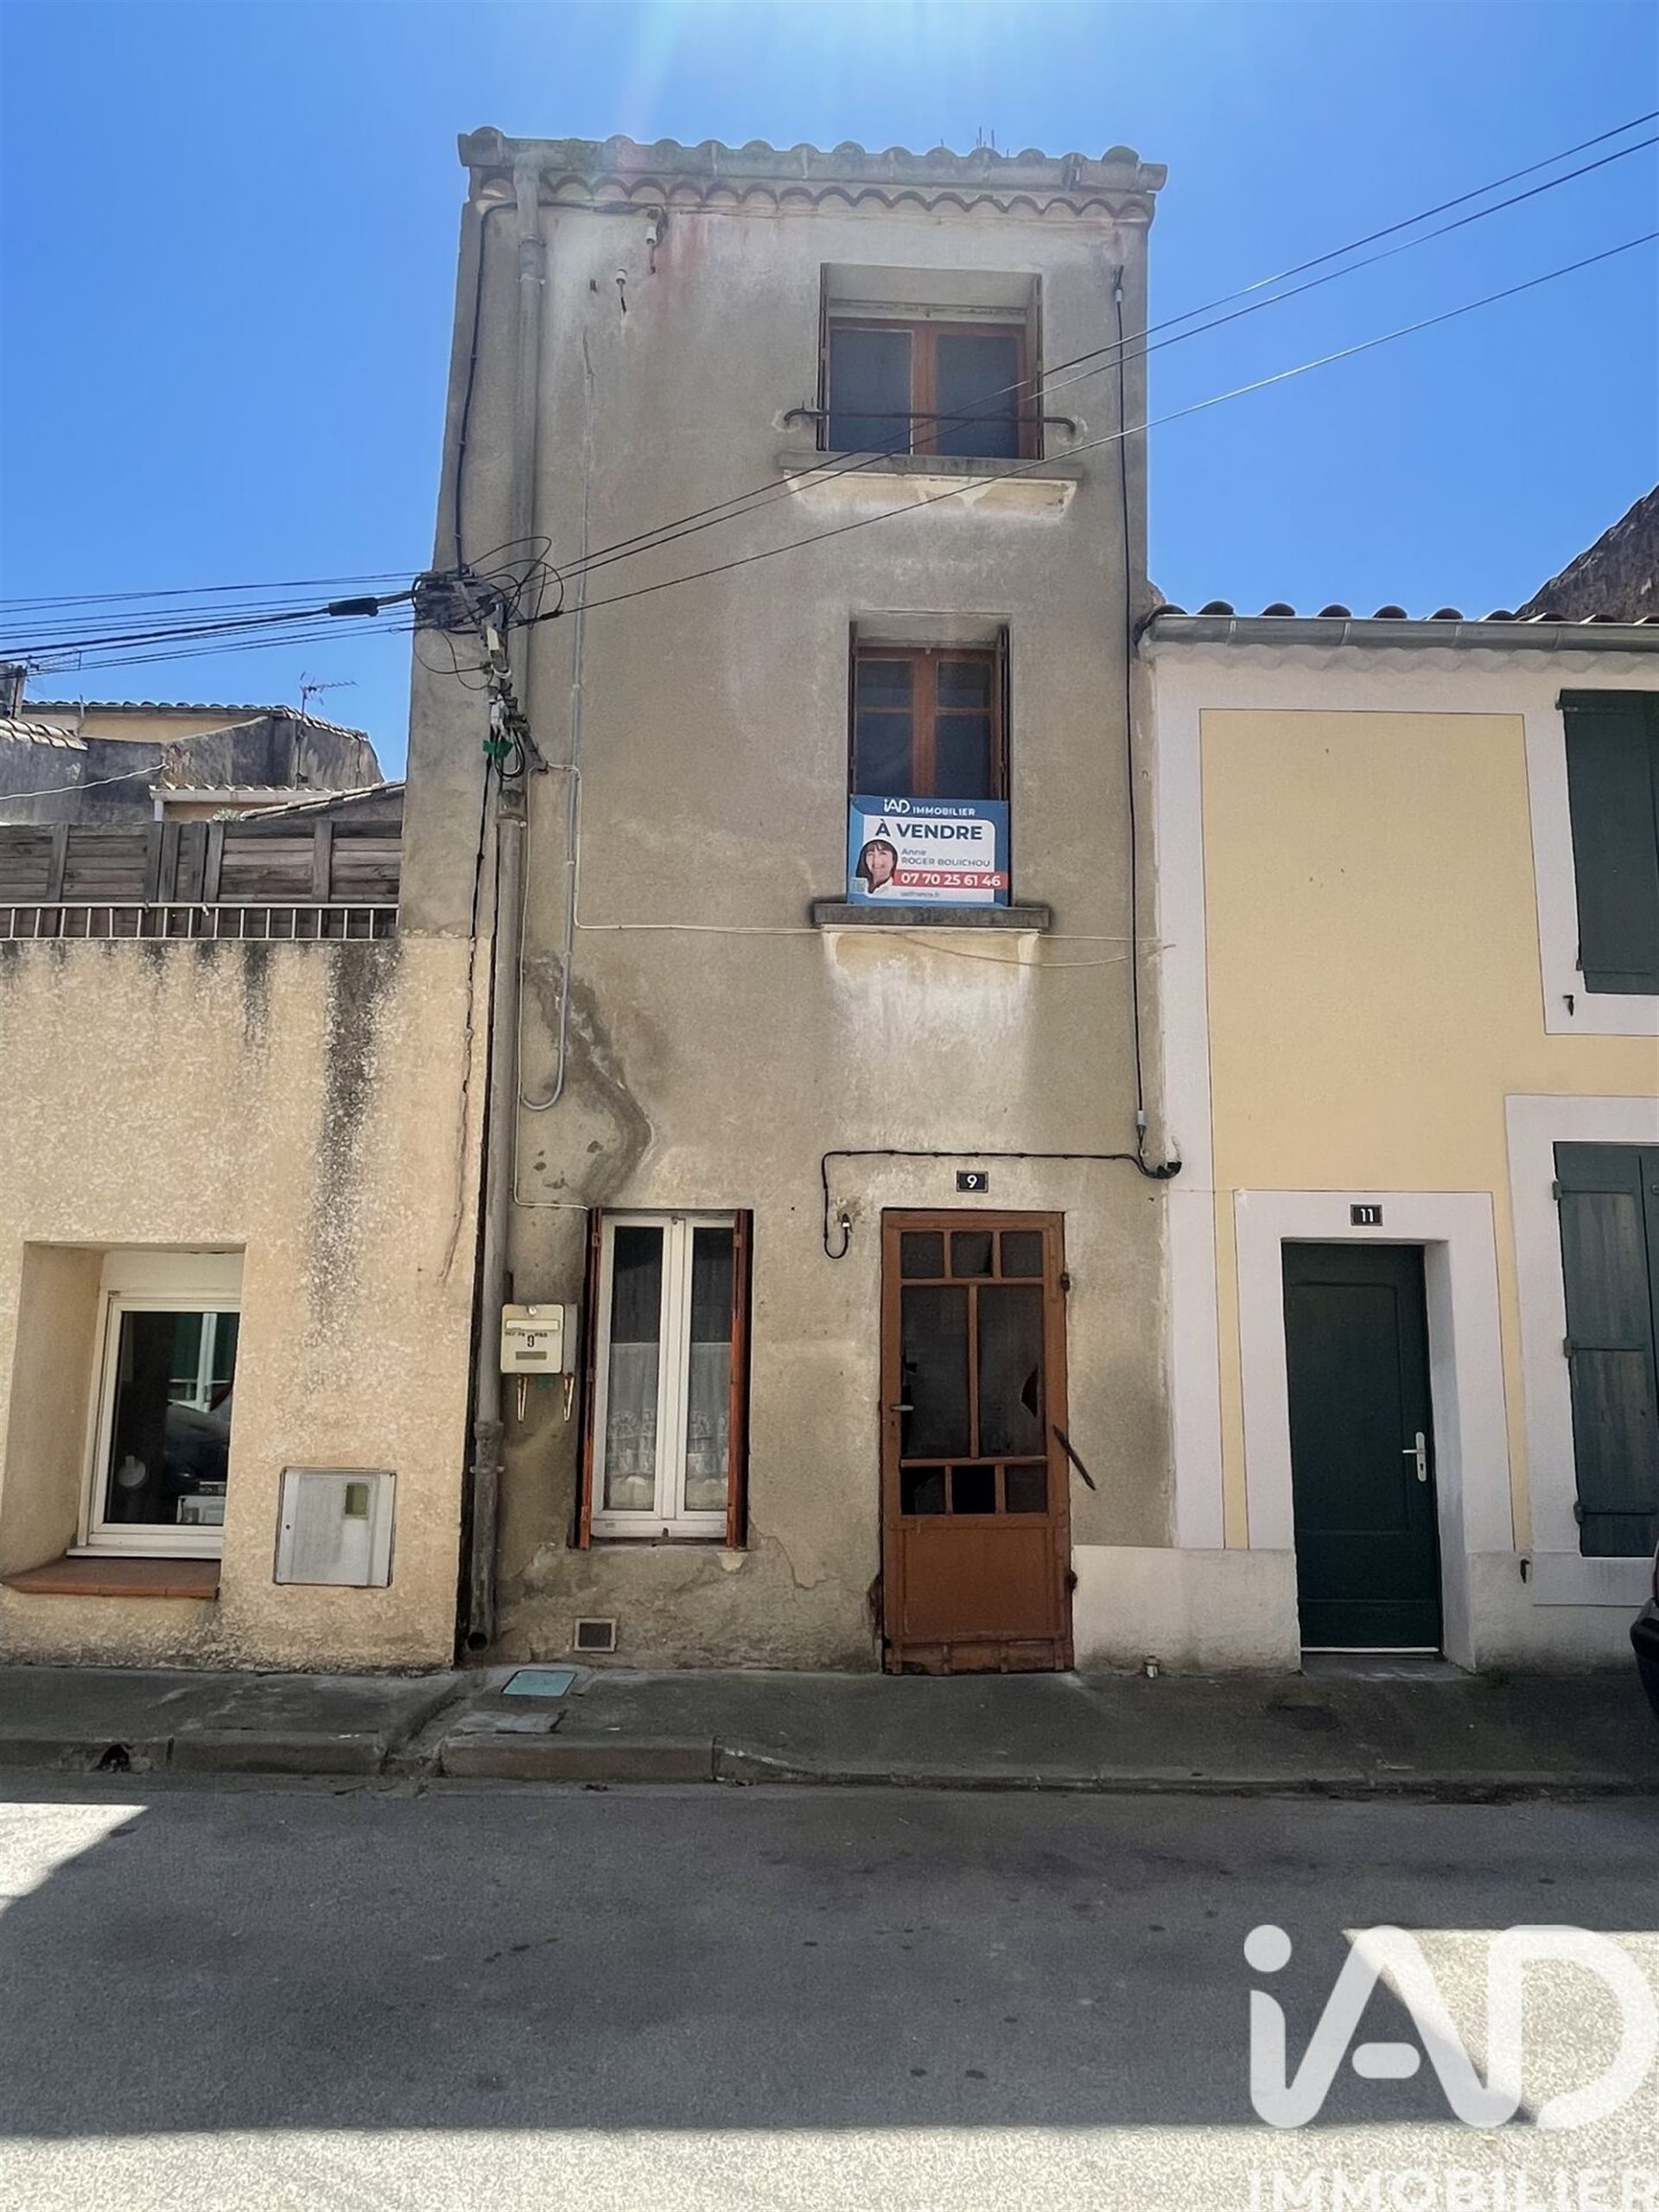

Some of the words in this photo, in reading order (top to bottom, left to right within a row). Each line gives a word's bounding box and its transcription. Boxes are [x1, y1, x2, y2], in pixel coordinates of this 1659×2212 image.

[912, 806, 976, 817] IMMOBILIER
[875, 818, 891, 836] À
[896, 823, 982, 840] VENDRE
[901, 873, 919, 884] 07
[922, 874, 940, 885] 70
[944, 874, 961, 886] 25
[964, 874, 978, 886] 61
[982, 875, 1001, 887] 46
[967, 1175, 977, 1188] 9
[1360, 1208, 1373, 1222] 11
[527, 1335, 534, 1347] 9
